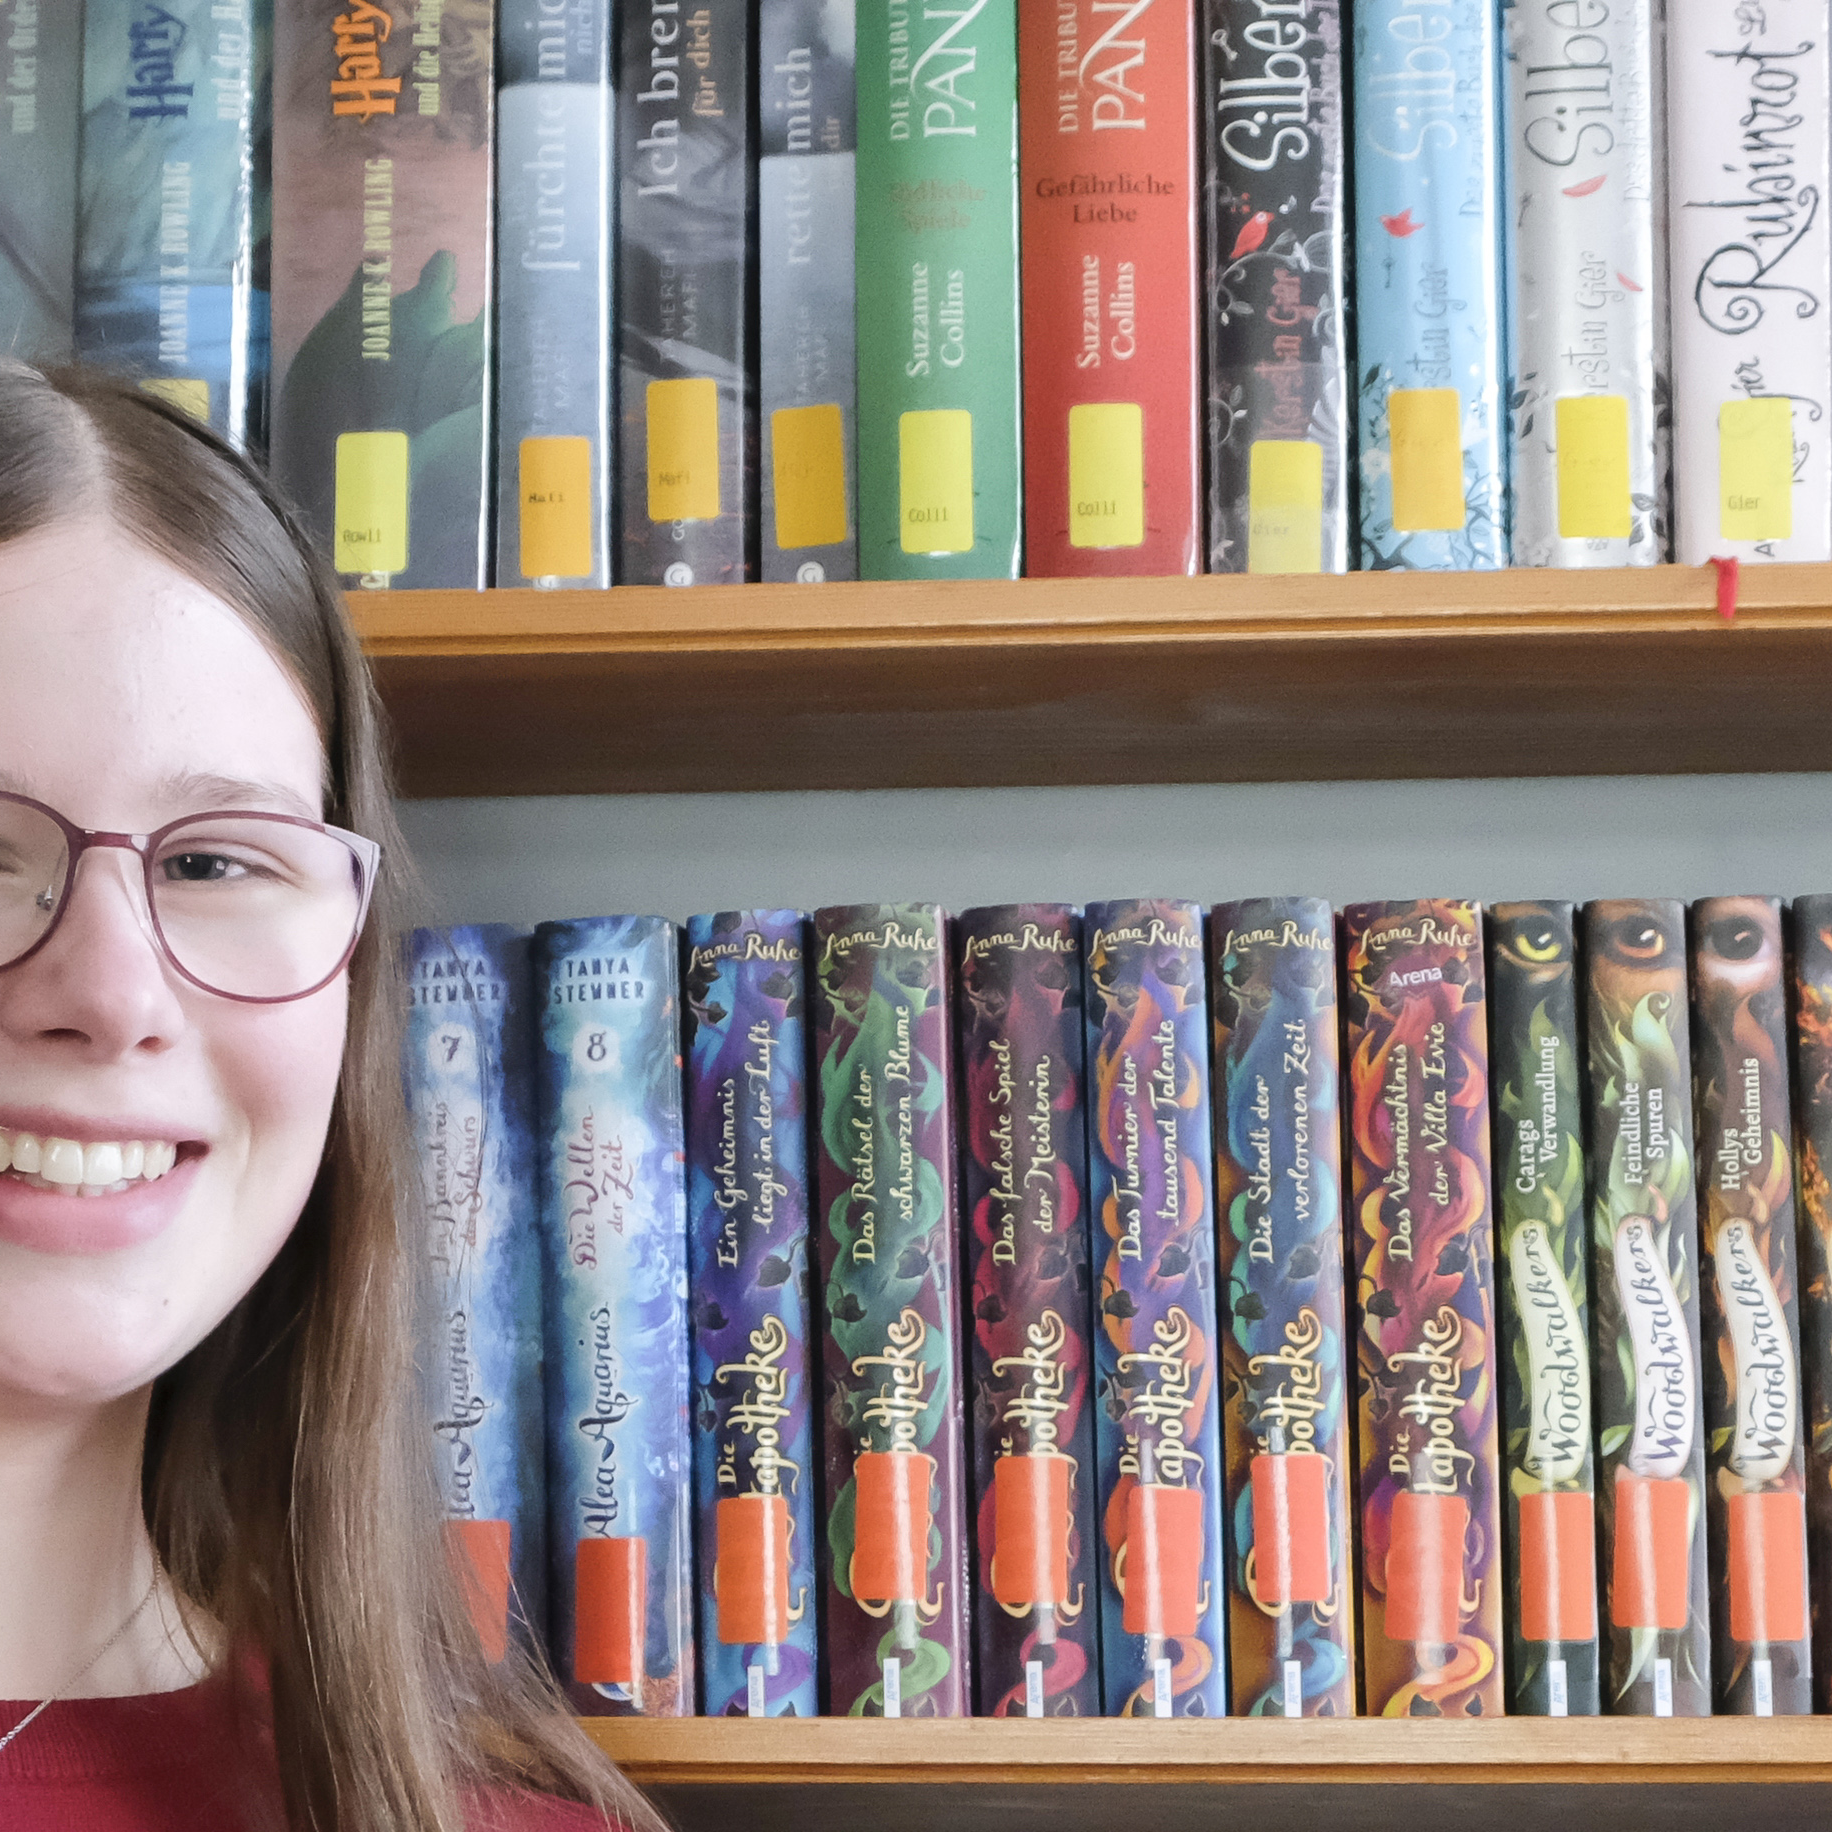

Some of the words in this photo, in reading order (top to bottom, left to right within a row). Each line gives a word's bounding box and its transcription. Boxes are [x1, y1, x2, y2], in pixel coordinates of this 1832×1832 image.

[125, 4, 194, 126] Harry
[330, 0, 402, 125] Harry
[686, 9, 713, 69] dich
[693, 76, 725, 117] für
[776, 47, 813, 151] mich
[888, 94, 911, 141] DIE
[1058, 87, 1080, 133] DIE
[639, 119, 681, 196] Ich
[1035, 174, 1176, 199] Gefährliche
[1682, 41, 1820, 335] Rubinrot
[363, 158, 393, 251] ROWLING
[1072, 207, 1139, 224] Liebe
[362, 256, 392, 277] K.
[361, 283, 391, 361] JOANNE
[906, 261, 931, 377] Suzanne
[939, 268, 966, 369] Collins
[1077, 254, 1102, 369] Suzanne
[1112, 261, 1137, 361] Collins
[553, 981, 648, 1006] STEWNER
[555, 956, 632, 978] TANYA
[884, 1003, 912, 1085] Blume
[990, 1038, 1020, 1105] Spiel
[1115, 1051, 1142, 1096] der
[1281, 1016, 1309, 1075] Zeit
[1421, 1020, 1447, 1078] Evie
[850, 1062, 877, 1111] der
[1026, 1053, 1056, 1185] Meisterin
[1248, 1072, 1272, 1120] der
[1383, 1041, 1412, 1200] Vermächtnis
[1419, 1085, 1451, 1155] Villa
[1533, 1034, 1561, 1163] Verwandlung
[1642, 1087, 1668, 1159] Spuren
[1739, 1057, 1764, 1165] Geheimnis
[563, 1104, 600, 1220] Wellen
[713, 1077, 740, 1208] Geheimnis
[848, 1116, 879, 1203] Rätsel
[891, 1091, 918, 1223] schwarzen
[988, 1109, 1021, 1201] falsche
[1114, 1101, 1142, 1201] Turnier
[1248, 1126, 1272, 1203] Stadt
[1287, 1082, 1312, 1222] verlorenen
[1514, 1118, 1540, 1194] Carags
[1619, 1082, 1645, 1185] Feindliche
[1719, 1127, 1747, 1191] Hollys
[1031, 1188, 1056, 1234] der
[1425, 1160, 1451, 1206] der
[571, 1222, 600, 1270] Die
[716, 1216, 741, 1268] Ein
[850, 1207, 878, 1264] Das
[991, 1207, 1017, 1264] Das
[1119, 1207, 1144, 1261] Das
[1248, 1209, 1274, 1263] Die
[1386, 1206, 1414, 1261] Das
[575, 1303, 639, 1458] Aquarius
[577, 1462, 620, 1537] Alea
